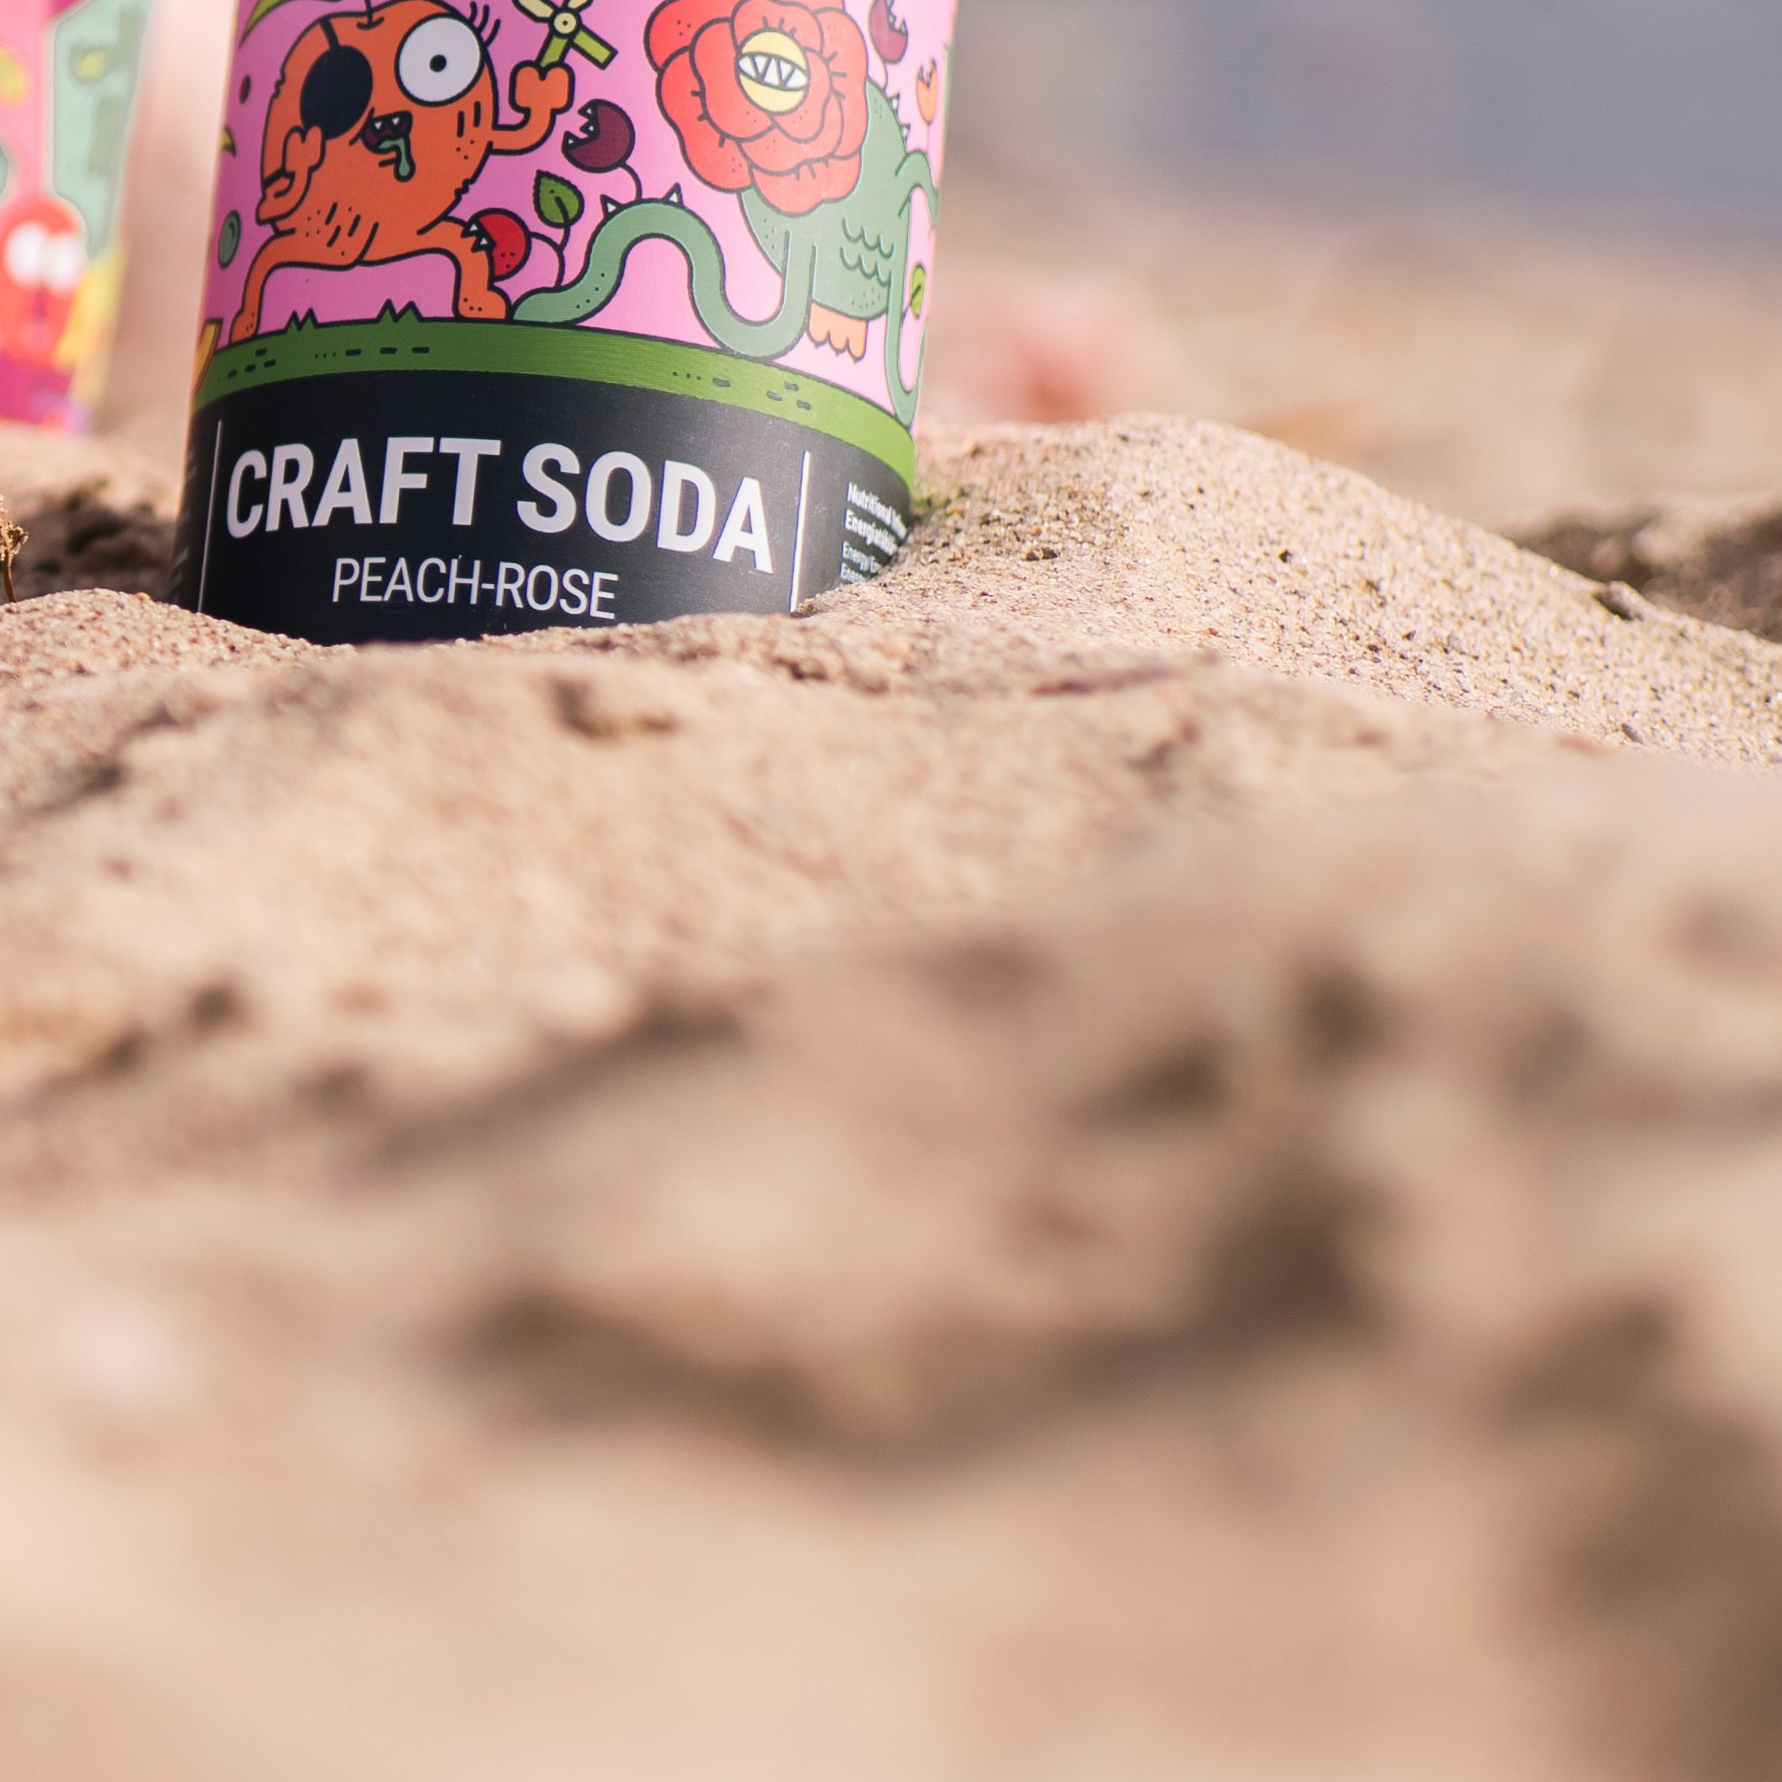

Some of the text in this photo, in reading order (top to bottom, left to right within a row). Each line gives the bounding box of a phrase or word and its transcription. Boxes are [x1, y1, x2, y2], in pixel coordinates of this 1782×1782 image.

[226, 437, 501, 538] CRAFT
[517, 443, 774, 574] SODA
[332, 557, 619, 619] PEACH-ROSE
